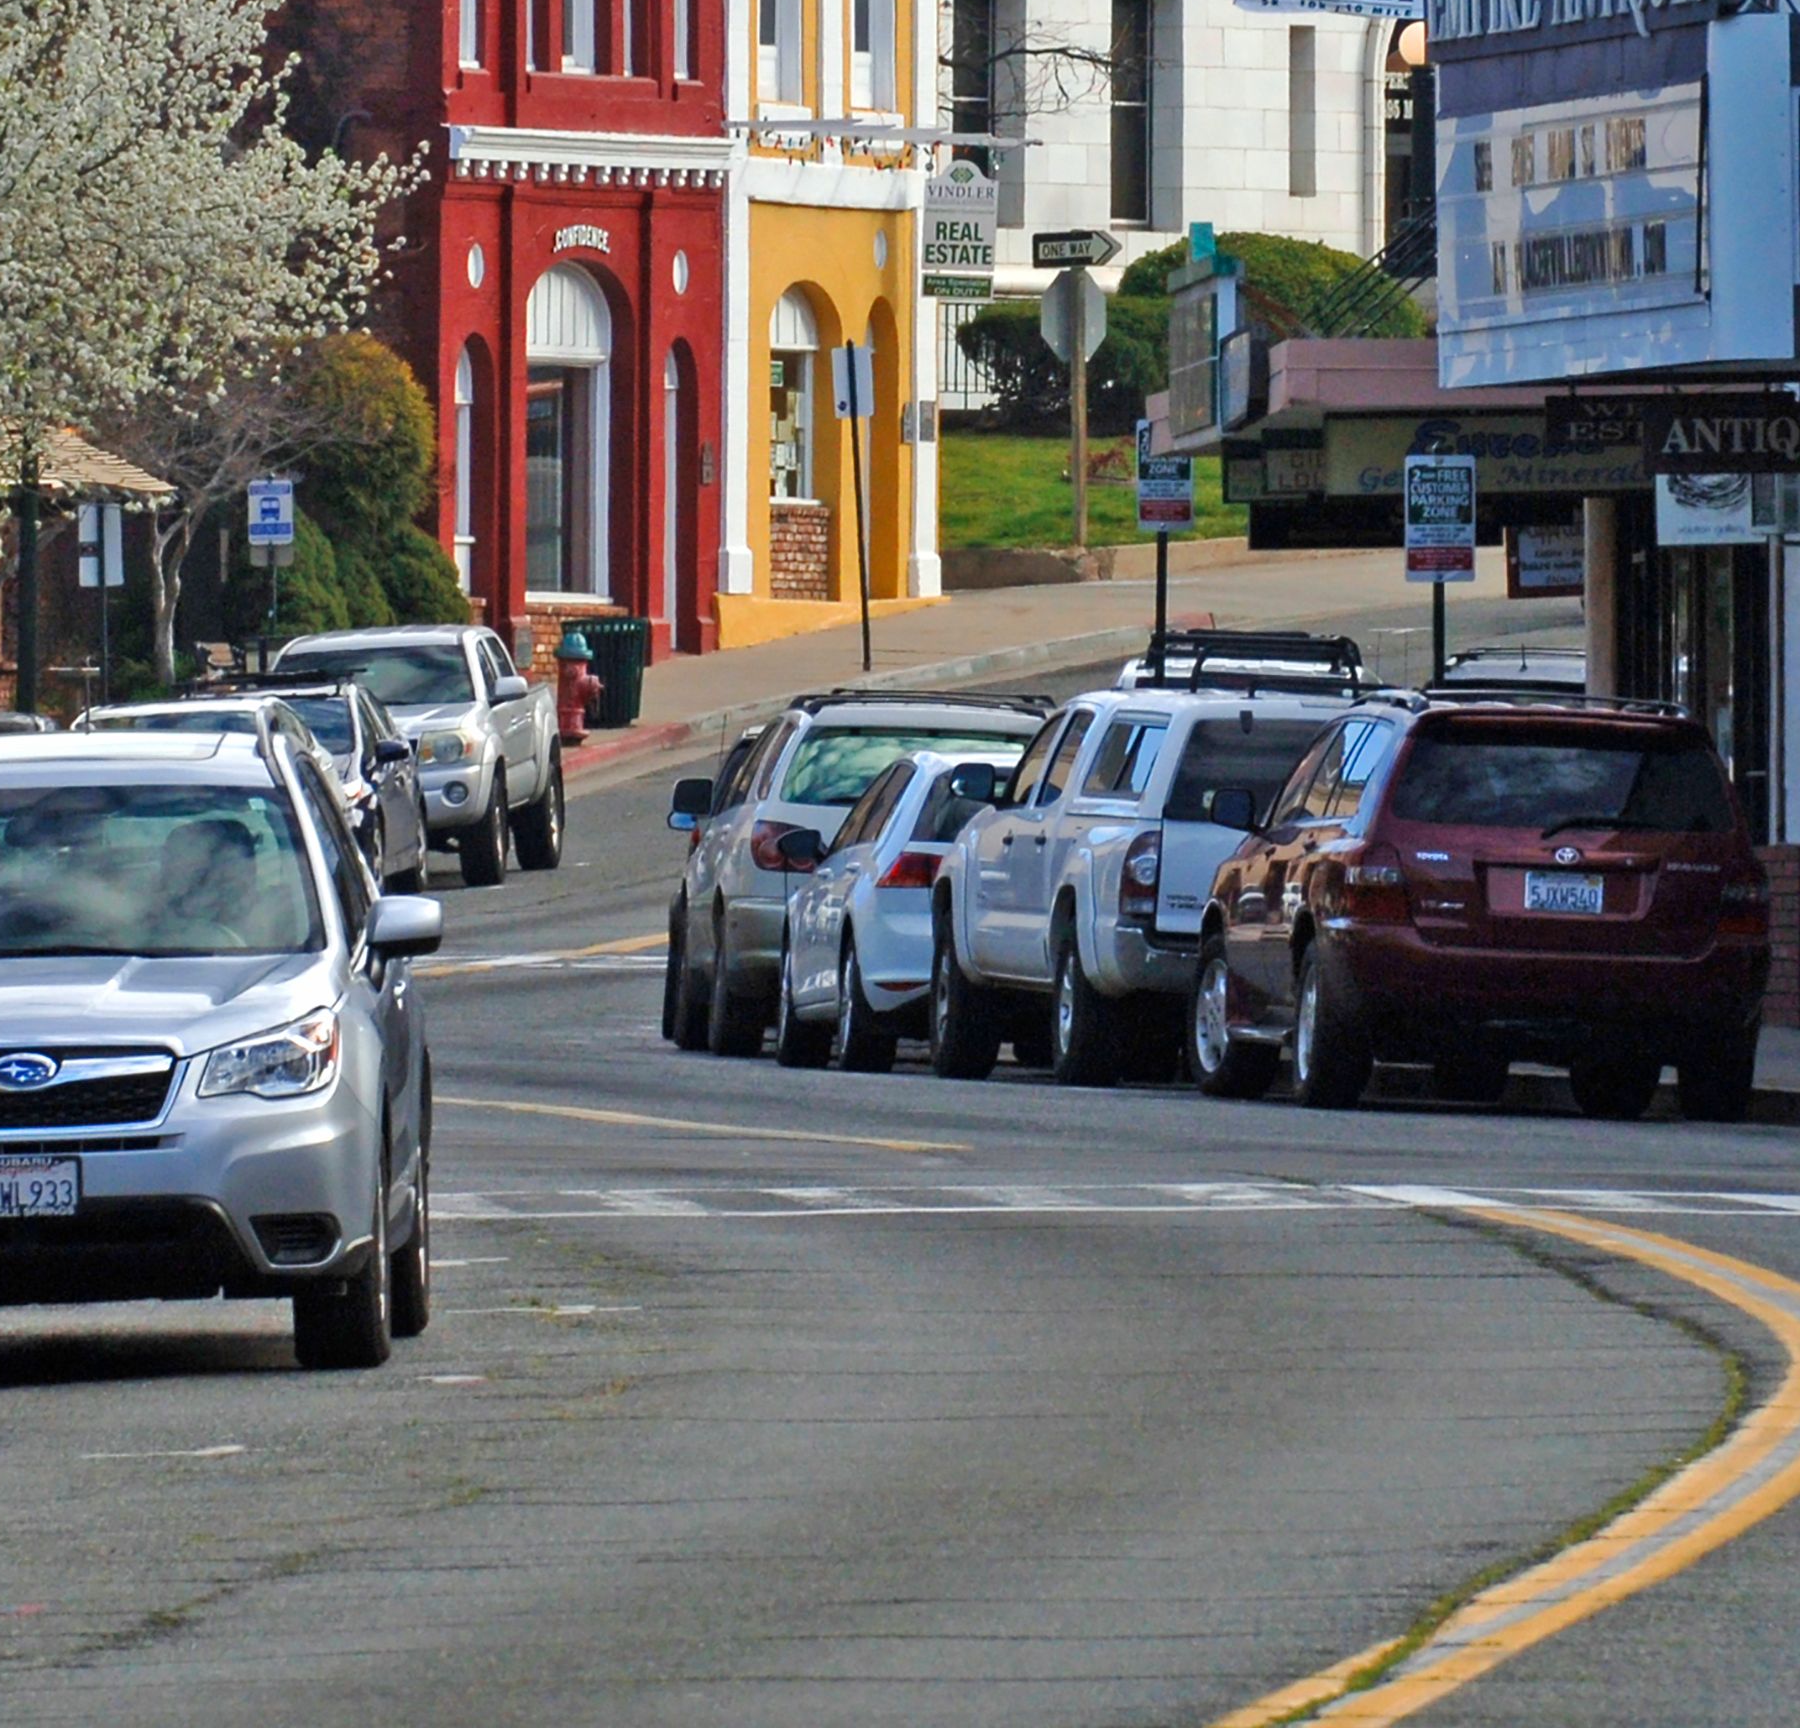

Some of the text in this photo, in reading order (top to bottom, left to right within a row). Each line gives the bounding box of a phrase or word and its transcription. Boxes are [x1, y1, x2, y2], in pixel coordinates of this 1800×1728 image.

[927, 184, 995, 199] VINDLER
[935, 221, 984, 242] REAL
[923, 243, 993, 265] ESTATE
[1042, 240, 1092, 258] ONE WAY
[1410, 482, 1470, 494] CUSTOMER
[1410, 494, 1469, 506] PARKING
[1422, 506, 1458, 518] ZONE
[1530, 882, 1599, 909] 5JXW540
